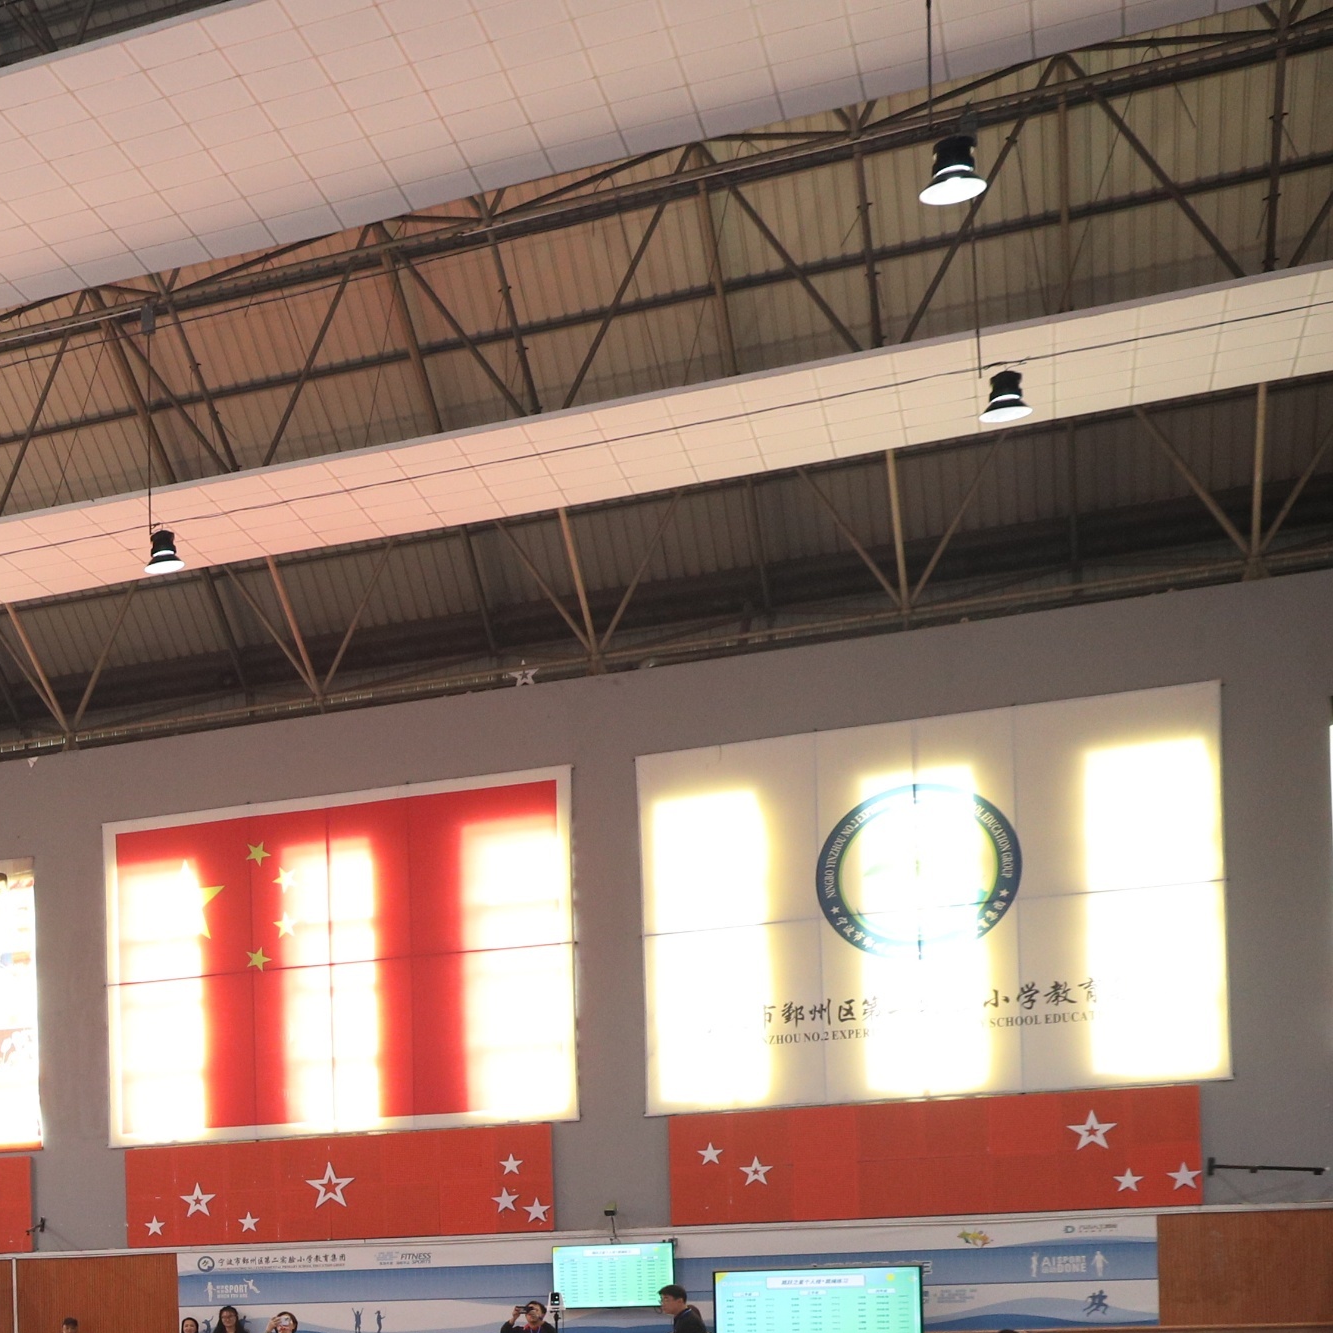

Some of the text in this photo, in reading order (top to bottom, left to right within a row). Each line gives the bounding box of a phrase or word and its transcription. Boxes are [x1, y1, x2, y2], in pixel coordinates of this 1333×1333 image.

[989, 1013, 1043, 1028] SCHOOL
[804, 1030, 829, 1043] NO.2
[399, 1252, 432, 1261] FITNESS
[224, 1283, 248, 1294] SPORT
